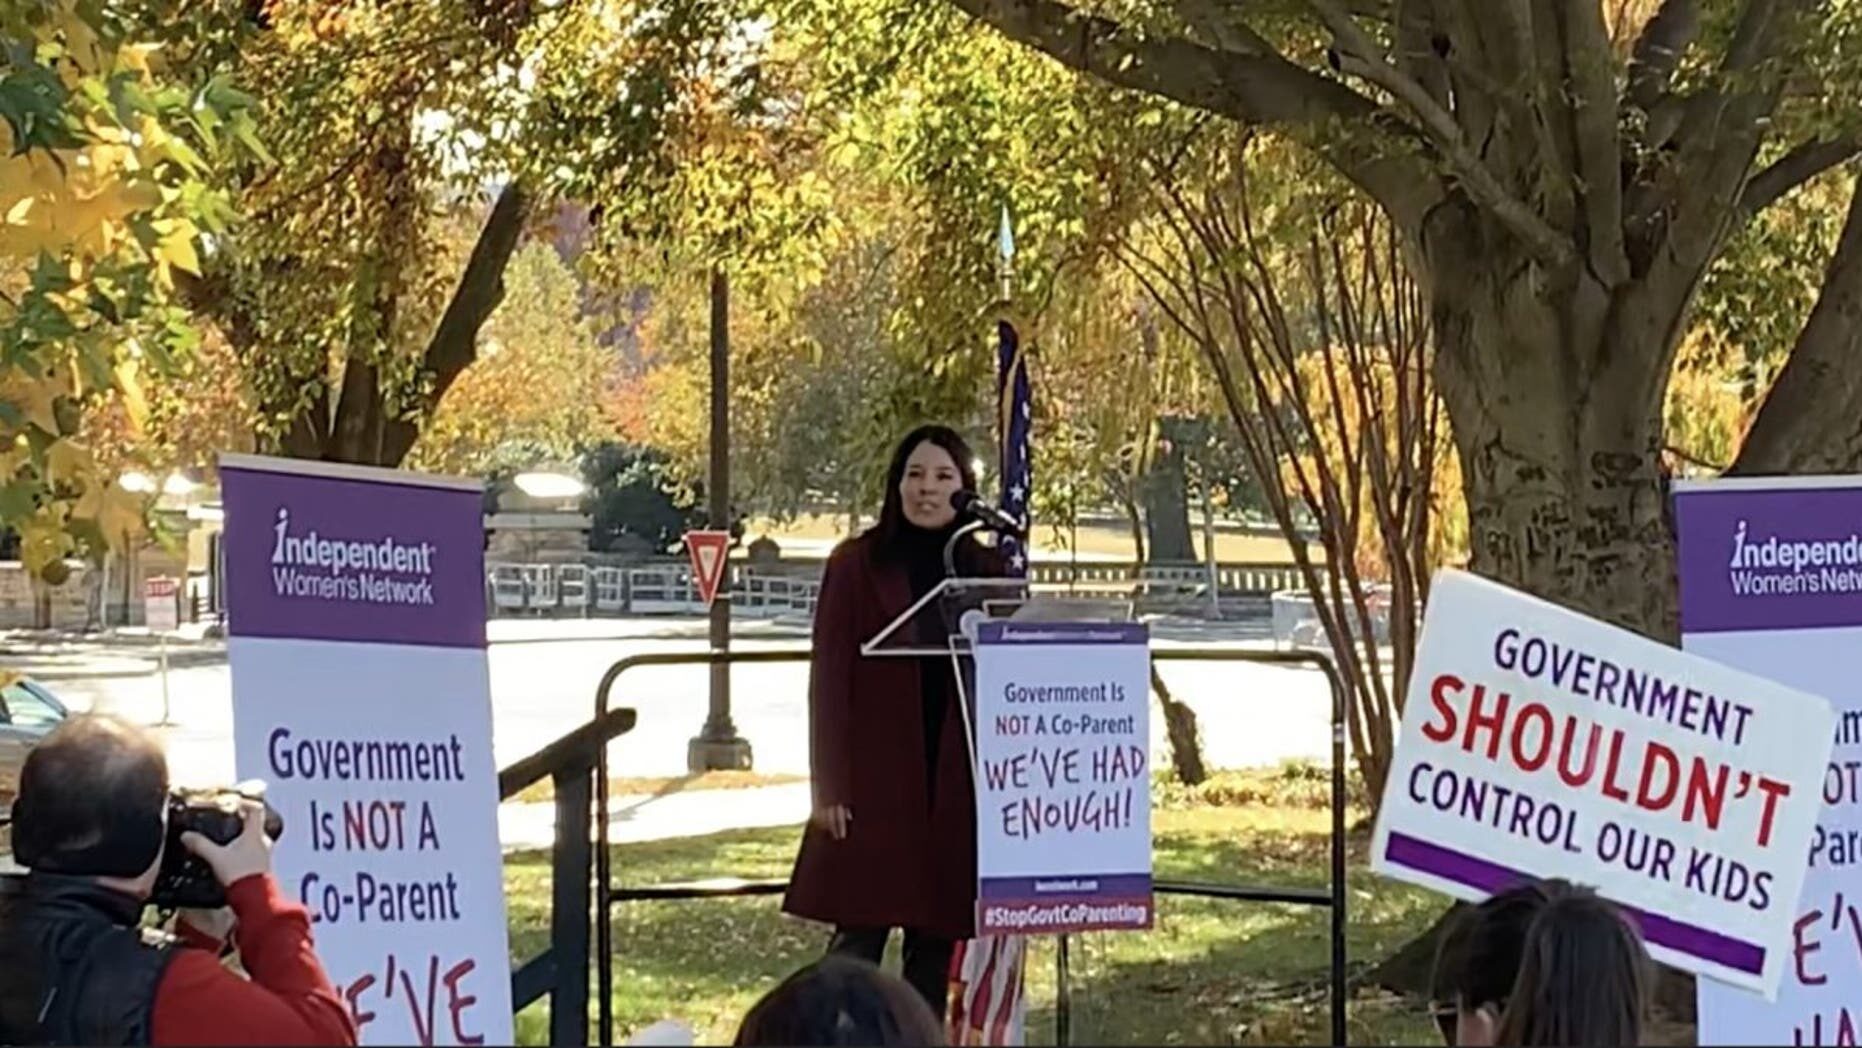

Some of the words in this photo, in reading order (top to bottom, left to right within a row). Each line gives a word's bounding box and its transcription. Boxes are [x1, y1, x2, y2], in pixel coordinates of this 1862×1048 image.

[272, 508, 432, 574] Independent
[273, 566, 359, 600] Women's
[360, 573, 434, 605] Network
[1730, 569, 1819, 595] Women's
[1004, 682, 1106, 703] Government
[1111, 682, 1125, 702] Is
[1494, 629, 1753, 746] GOVERNMENT
[996, 714, 1030, 736] NOT
[1035, 715, 1047, 735] A
[1052, 714, 1134, 735] Co-Parent
[269, 727, 465, 781] Government
[984, 747, 1080, 792] WE'VE
[1093, 745, 1145, 783] HAD
[1421, 674, 1791, 847] SHOULDN'T
[1822, 761, 1862, 805] OT
[311, 800, 335, 851] Is
[343, 800, 406, 851] NOT
[418, 801, 440, 851] A
[1002, 787, 1132, 840] ENOUGH!
[1408, 763, 1582, 854] CONTROL
[1597, 822, 1676, 881] OUR
[1685, 847, 1774, 911] KIDS
[300, 871, 461, 923] Co-Parent
[984, 902, 1147, 928] #StopGovtCoParenting
[337, 954, 485, 1047] E'VE
